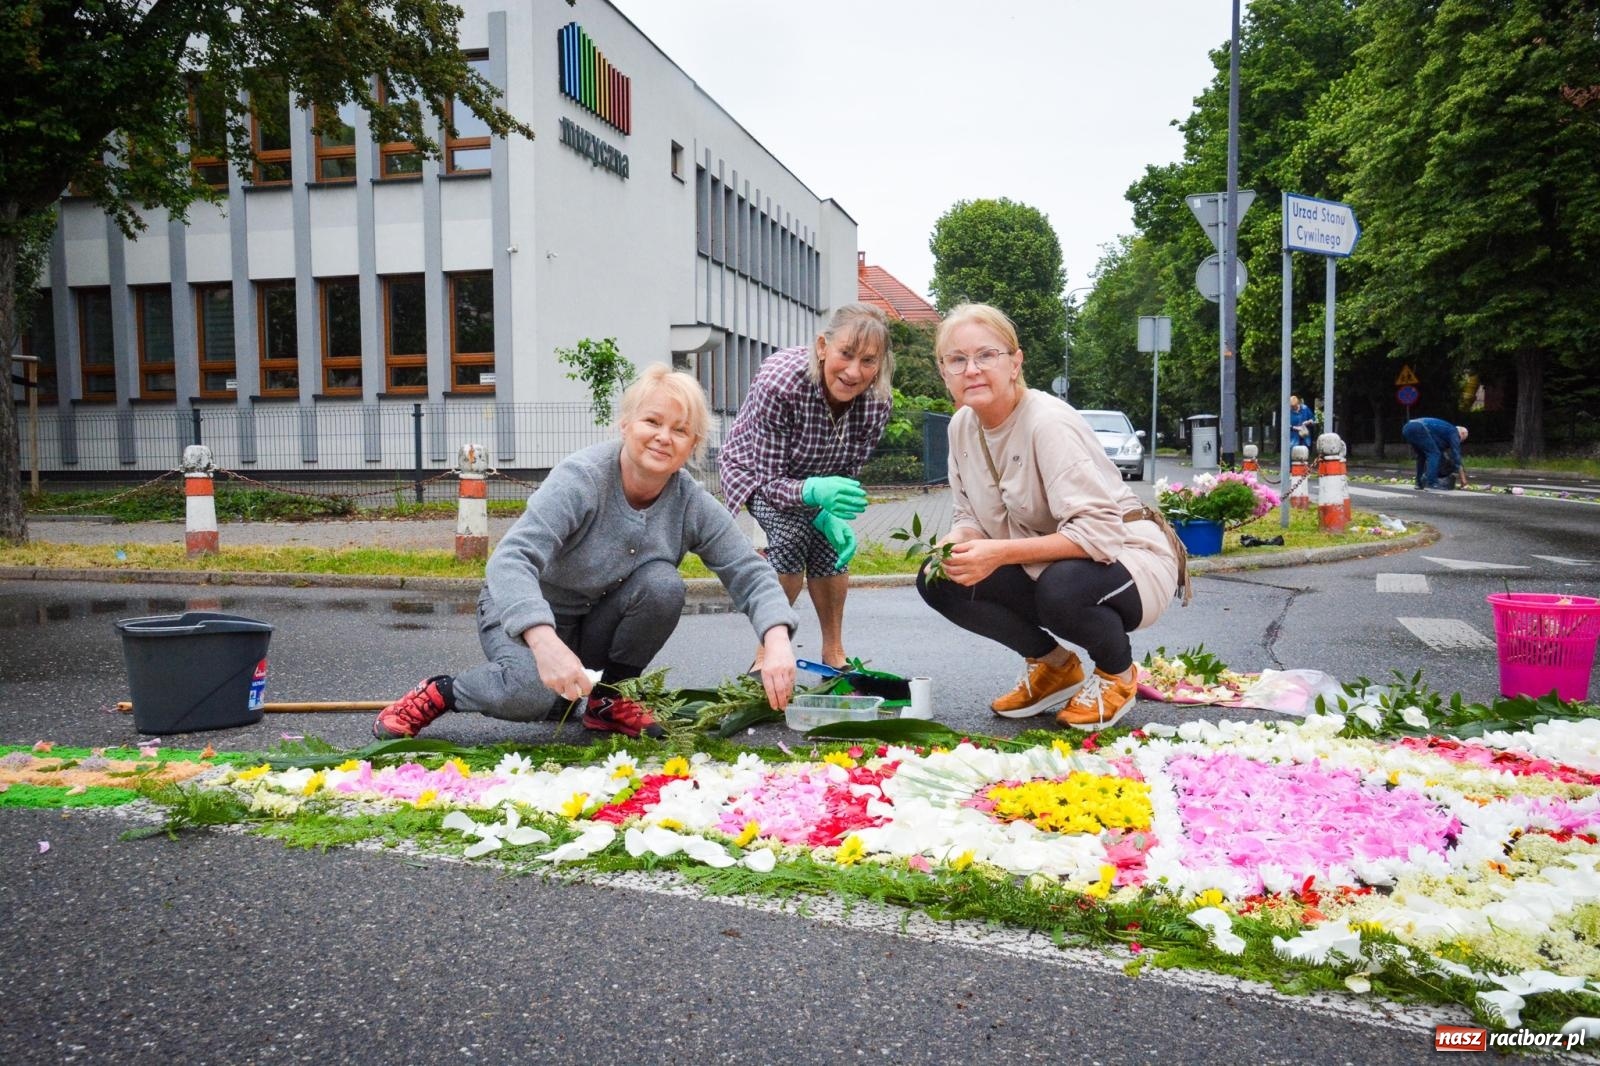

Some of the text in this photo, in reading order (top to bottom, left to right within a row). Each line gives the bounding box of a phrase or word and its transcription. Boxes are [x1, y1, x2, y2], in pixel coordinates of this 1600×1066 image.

[559, 116, 629, 179] muzyczna
[1321, 208, 1346, 226] Stanu
[1296, 225, 1341, 249] Cywilnego
